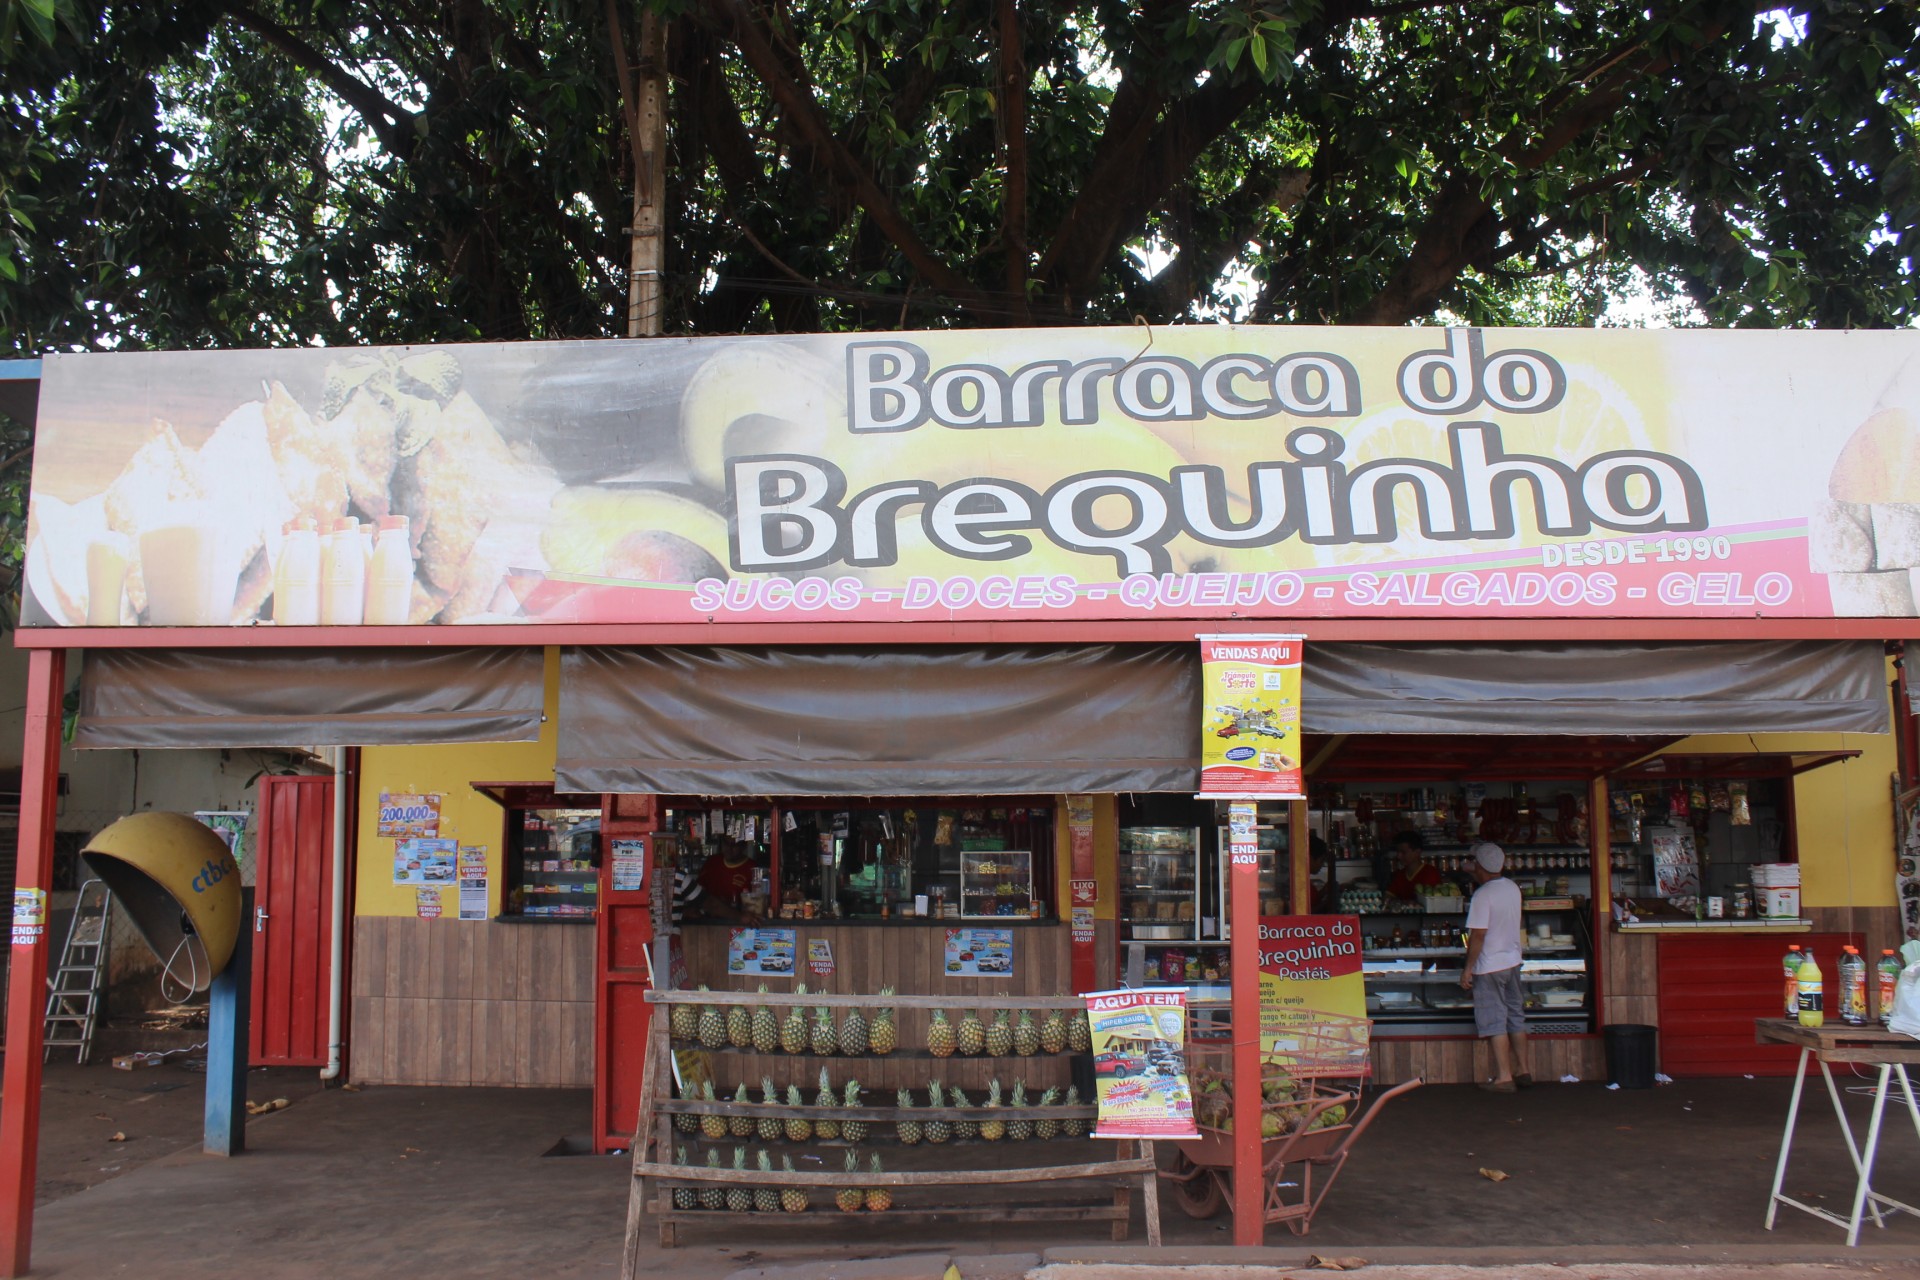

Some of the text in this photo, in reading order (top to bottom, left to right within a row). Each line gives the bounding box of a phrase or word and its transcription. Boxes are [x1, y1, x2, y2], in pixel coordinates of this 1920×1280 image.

[846, 328, 1567, 434] Barraca do
[1541, 536, 1732, 568] DESDE 1990
[692, 576, 864, 612] SUCOS
[900, 573, 1078, 609] DOCES
[1118, 571, 1305, 611] QUEIJO
[1344, 570, 1616, 607] SALGADOS
[1657, 570, 1794, 607] GELO
[1210, 647, 1290, 661] VENDAS AQUI
[1073, 882, 1095, 890] LIXO
[1258, 920, 1353, 940] Barraca do
[12, 935, 37, 944] AQUI
[1279, 967, 1331, 981] Pastéis
[1094, 993, 1180, 1011] AQUI TEM
[1283, 996, 1305, 1004] queijo
[1102, 1017, 1123, 1026] HIPER
[1288, 1013, 1315, 1021] catupiy
